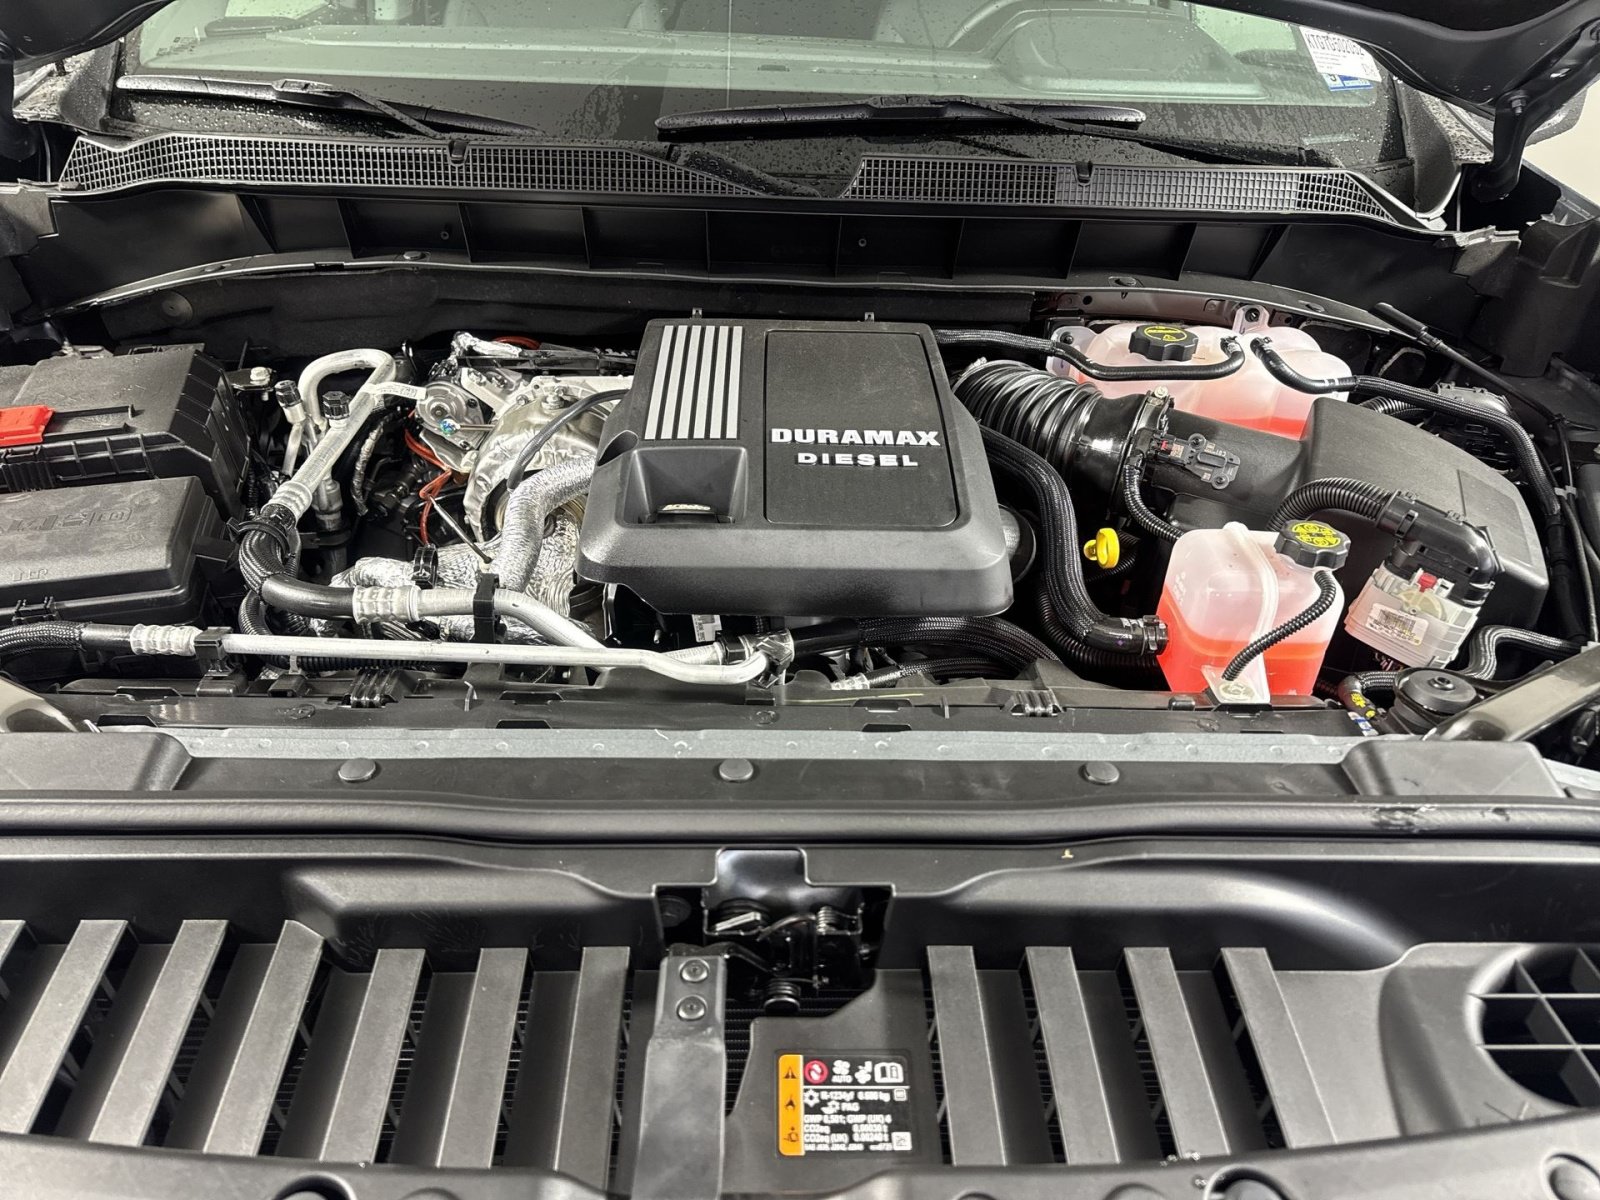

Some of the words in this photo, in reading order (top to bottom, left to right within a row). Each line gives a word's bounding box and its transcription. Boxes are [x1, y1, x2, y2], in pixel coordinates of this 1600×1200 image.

[771, 428, 941, 446] DURAMAX
[797, 452, 918, 467] DIESEL
[832, 1075, 852, 1083] AUTO
[841, 1102, 860, 1111] PAG
[804, 1114, 822, 1123] GWP
[846, 1114, 866, 1123] GWP
